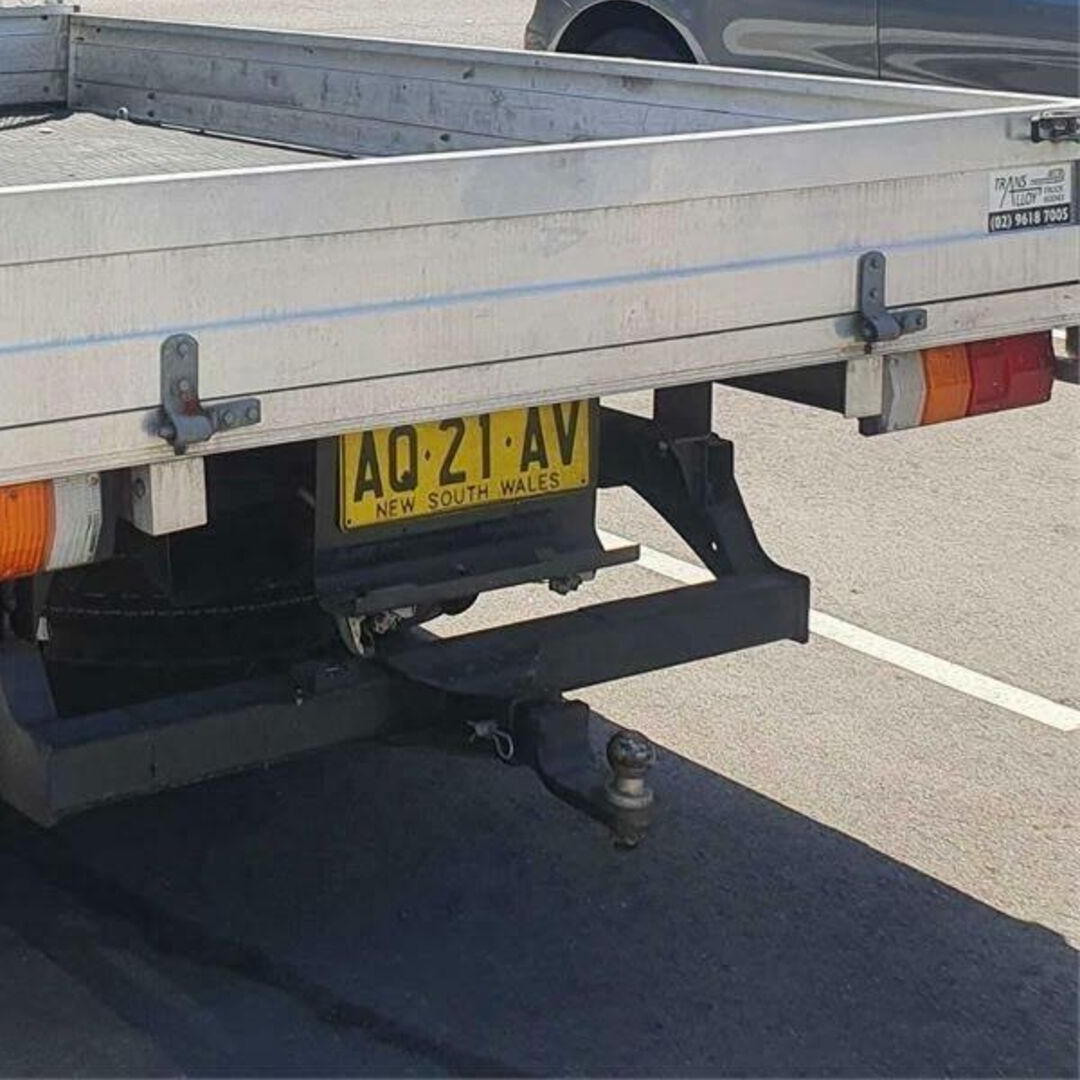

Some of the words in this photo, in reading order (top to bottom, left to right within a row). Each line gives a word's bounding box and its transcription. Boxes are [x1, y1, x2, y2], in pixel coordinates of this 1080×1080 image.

[991, 214, 1012, 231] (02)
[1014, 210, 1041, 226] 9618
[1042, 207, 1069, 223] 7005
[376, 496, 416, 518] NEW
[428, 484, 489, 511] SOUTH
[500, 472, 561, 498] WALES
